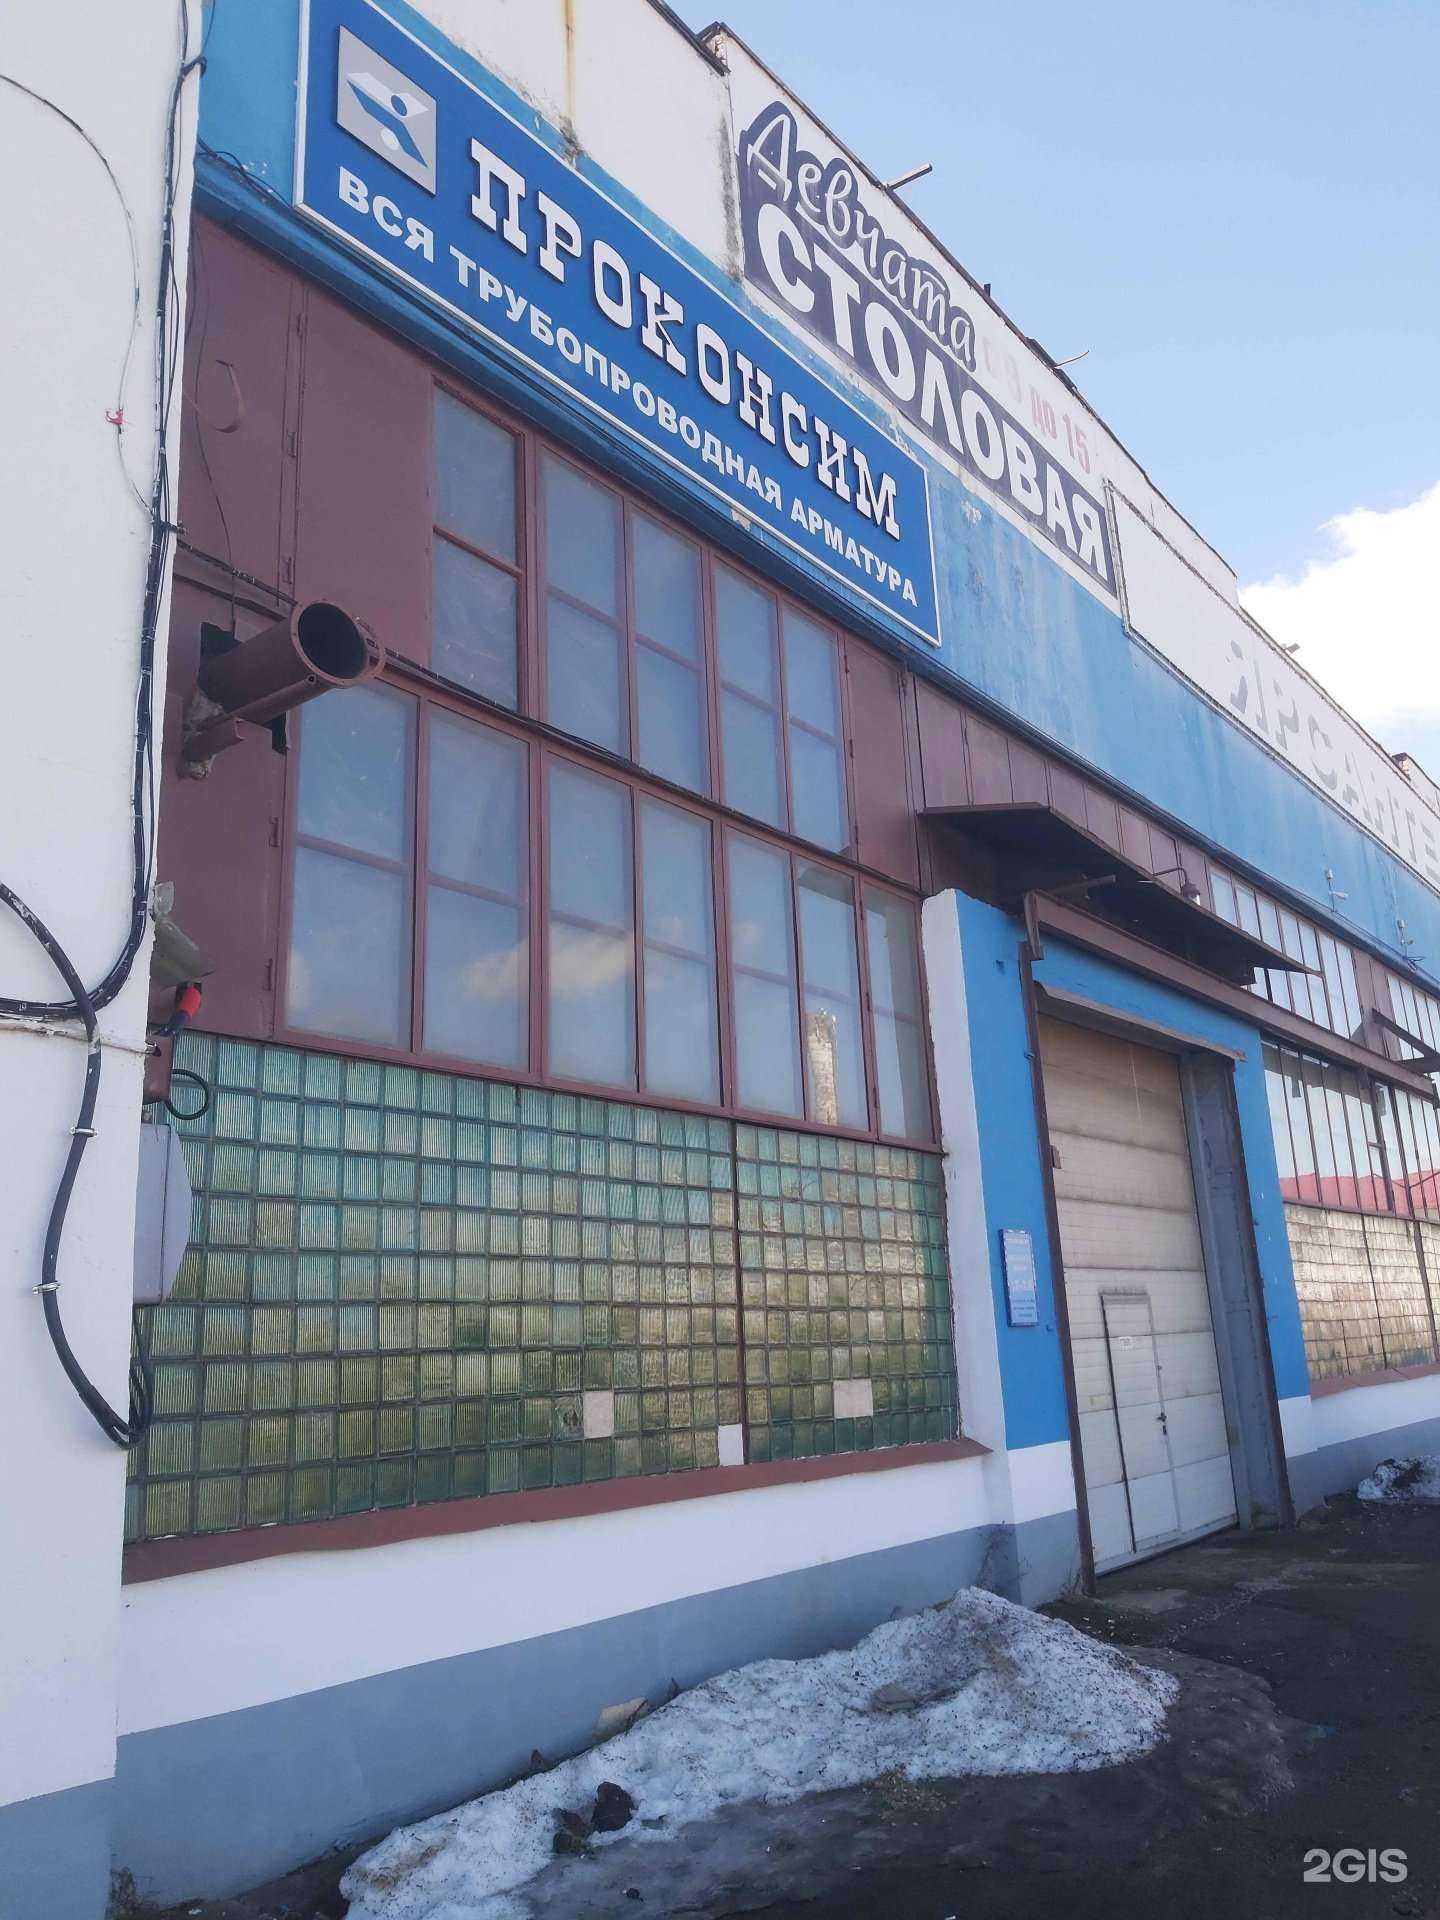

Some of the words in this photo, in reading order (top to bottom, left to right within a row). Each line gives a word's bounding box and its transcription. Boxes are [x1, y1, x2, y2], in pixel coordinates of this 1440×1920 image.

[338, 165, 434, 264] ВСЯ
[449, 244, 783, 512] ТРУБОПРОВОДНАЯ
[789, 497, 919, 608] АРМАТУРА
[470, 136, 900, 541] ПРОКОНСИМ
[746, 113, 972, 364] Девчата
[757, 202, 1108, 582] СТОЛОВАЯ
